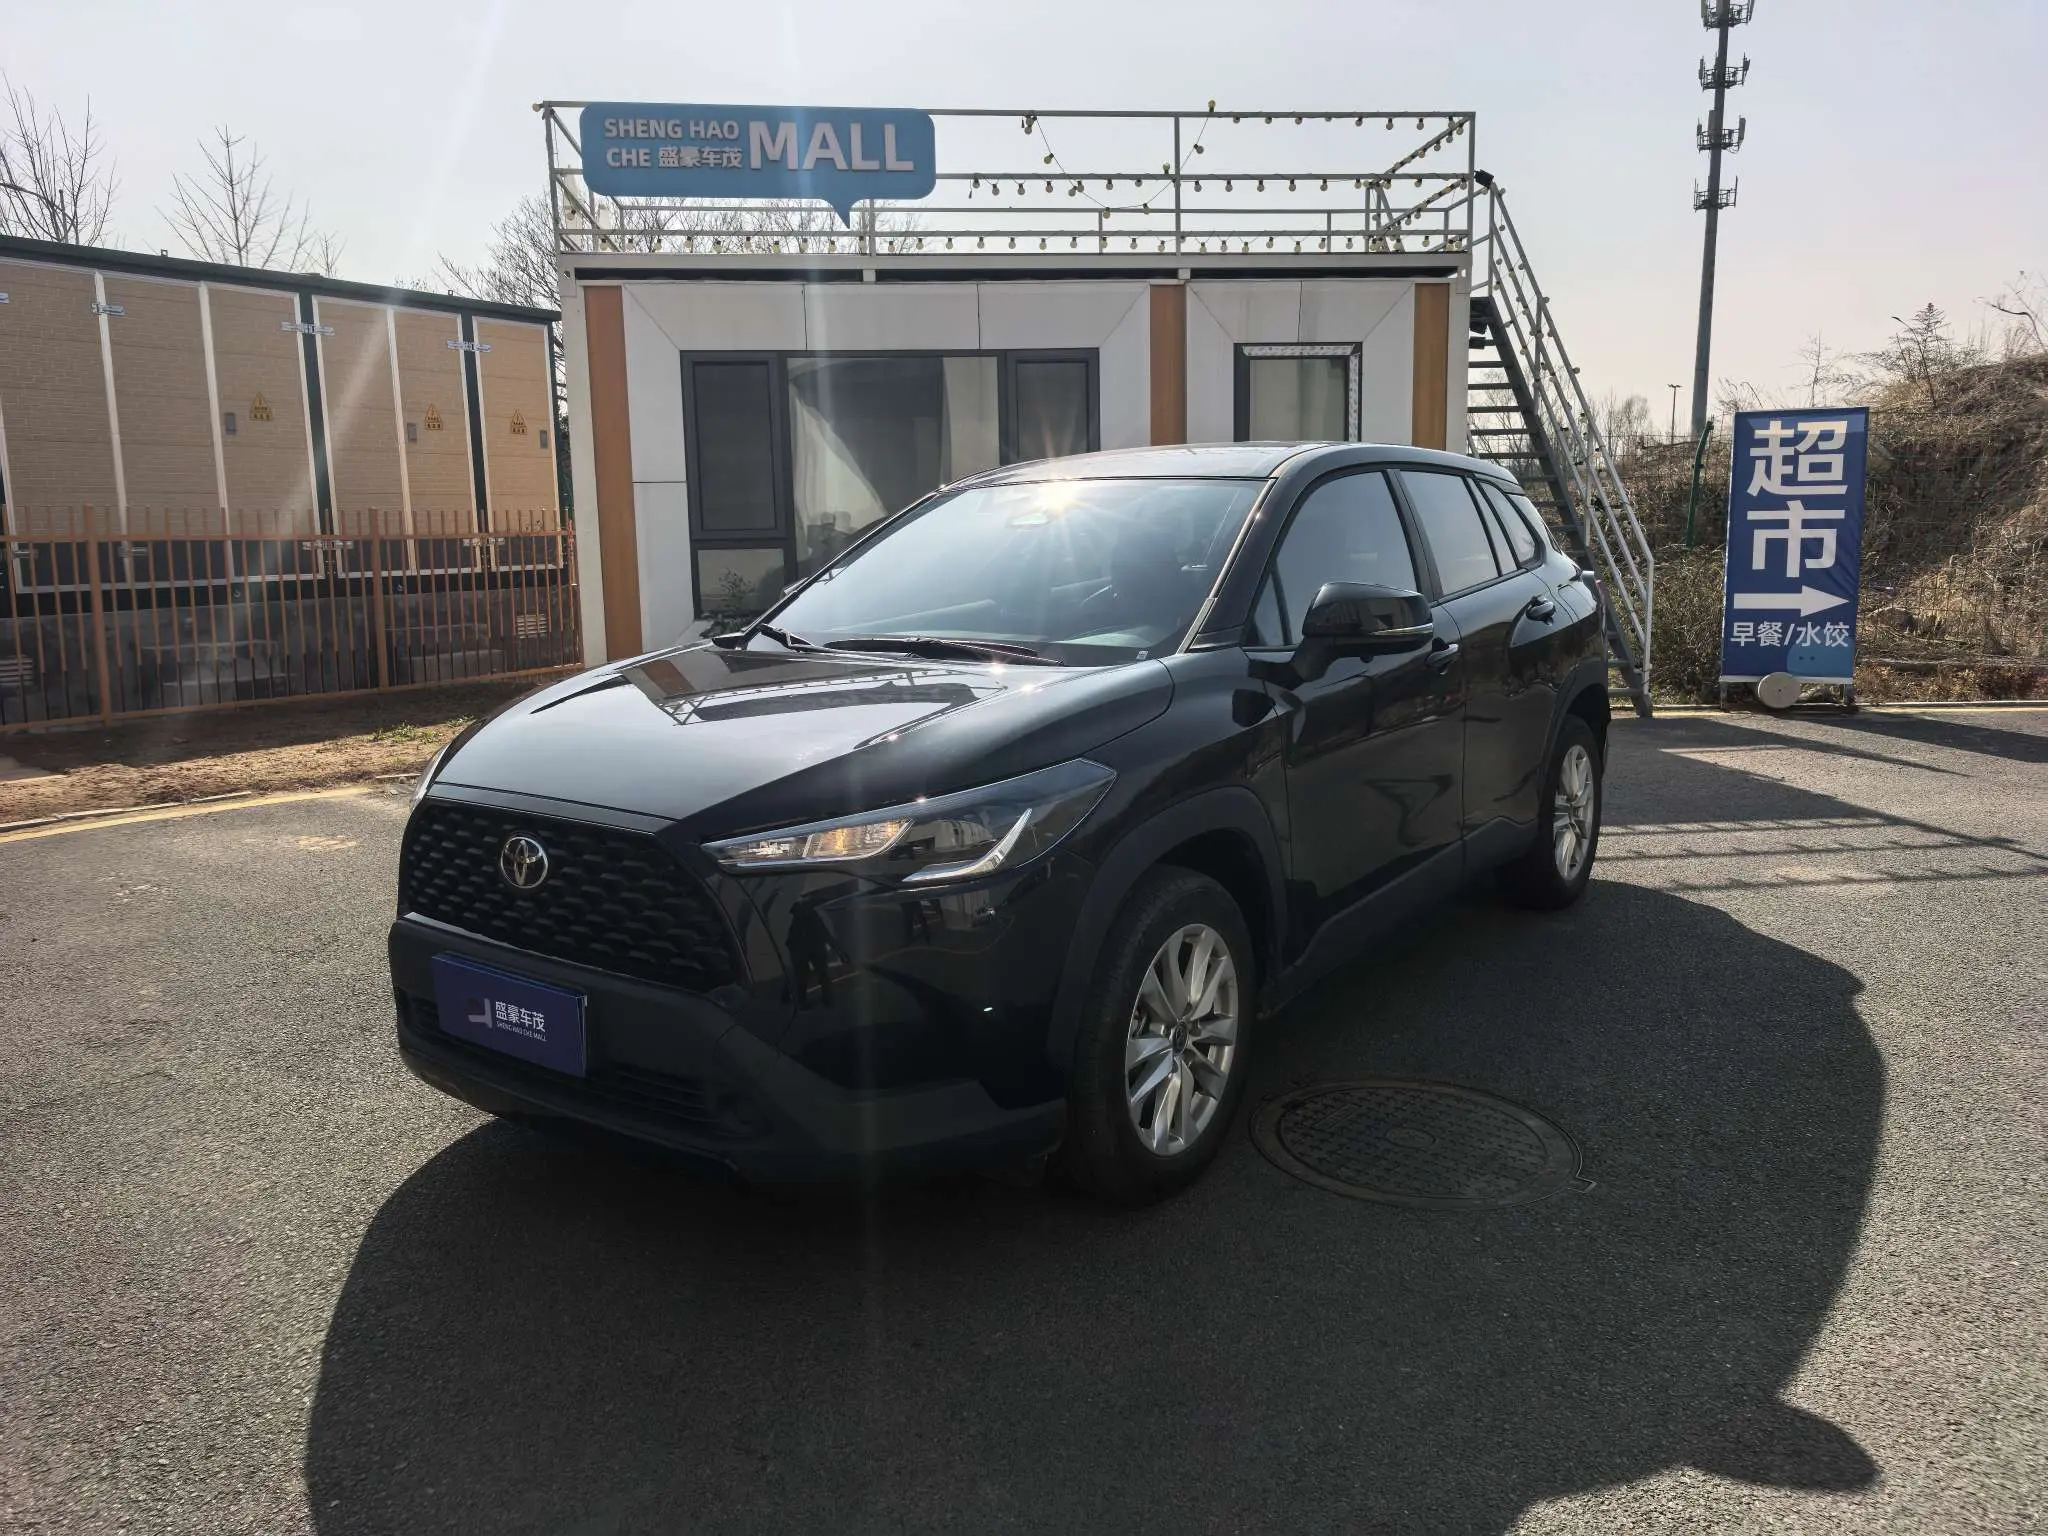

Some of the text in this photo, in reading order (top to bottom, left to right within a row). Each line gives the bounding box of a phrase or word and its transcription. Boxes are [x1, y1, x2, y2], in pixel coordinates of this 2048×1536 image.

[604, 118, 739, 140] SHENG HAO
[606, 146, 743, 169] CHE 盛豪车茂
[749, 121, 914, 172] MALL
[1747, 420, 1848, 577] 超市
[1731, 621, 1850, 648] 早餐/水饺
[495, 1001, 546, 1032] 盛豪车茂
